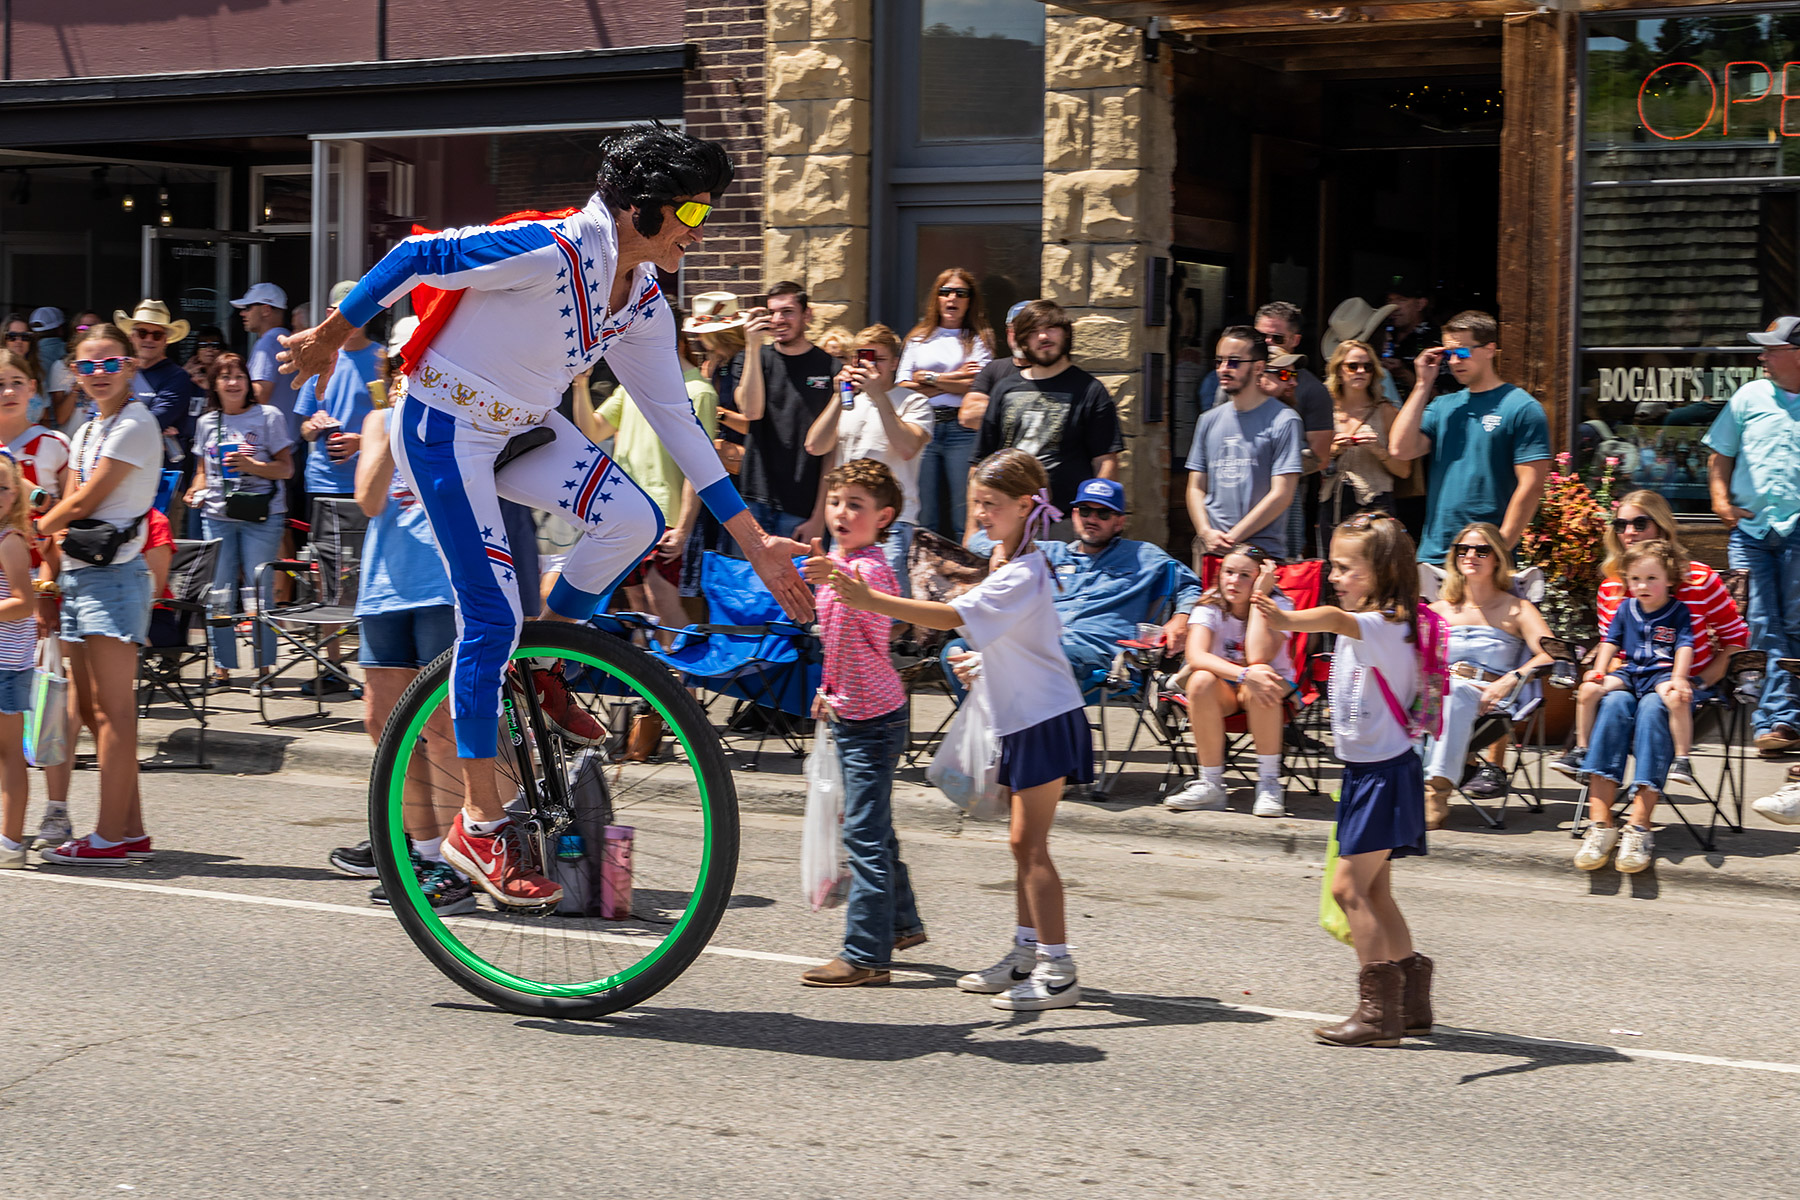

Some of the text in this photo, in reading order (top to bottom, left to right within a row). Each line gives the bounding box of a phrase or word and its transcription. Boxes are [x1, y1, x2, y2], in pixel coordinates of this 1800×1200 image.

[1598, 367, 1704, 402] BOGART'S
[1653, 626, 1676, 643] 25
[502, 698, 519, 739] Oracle
